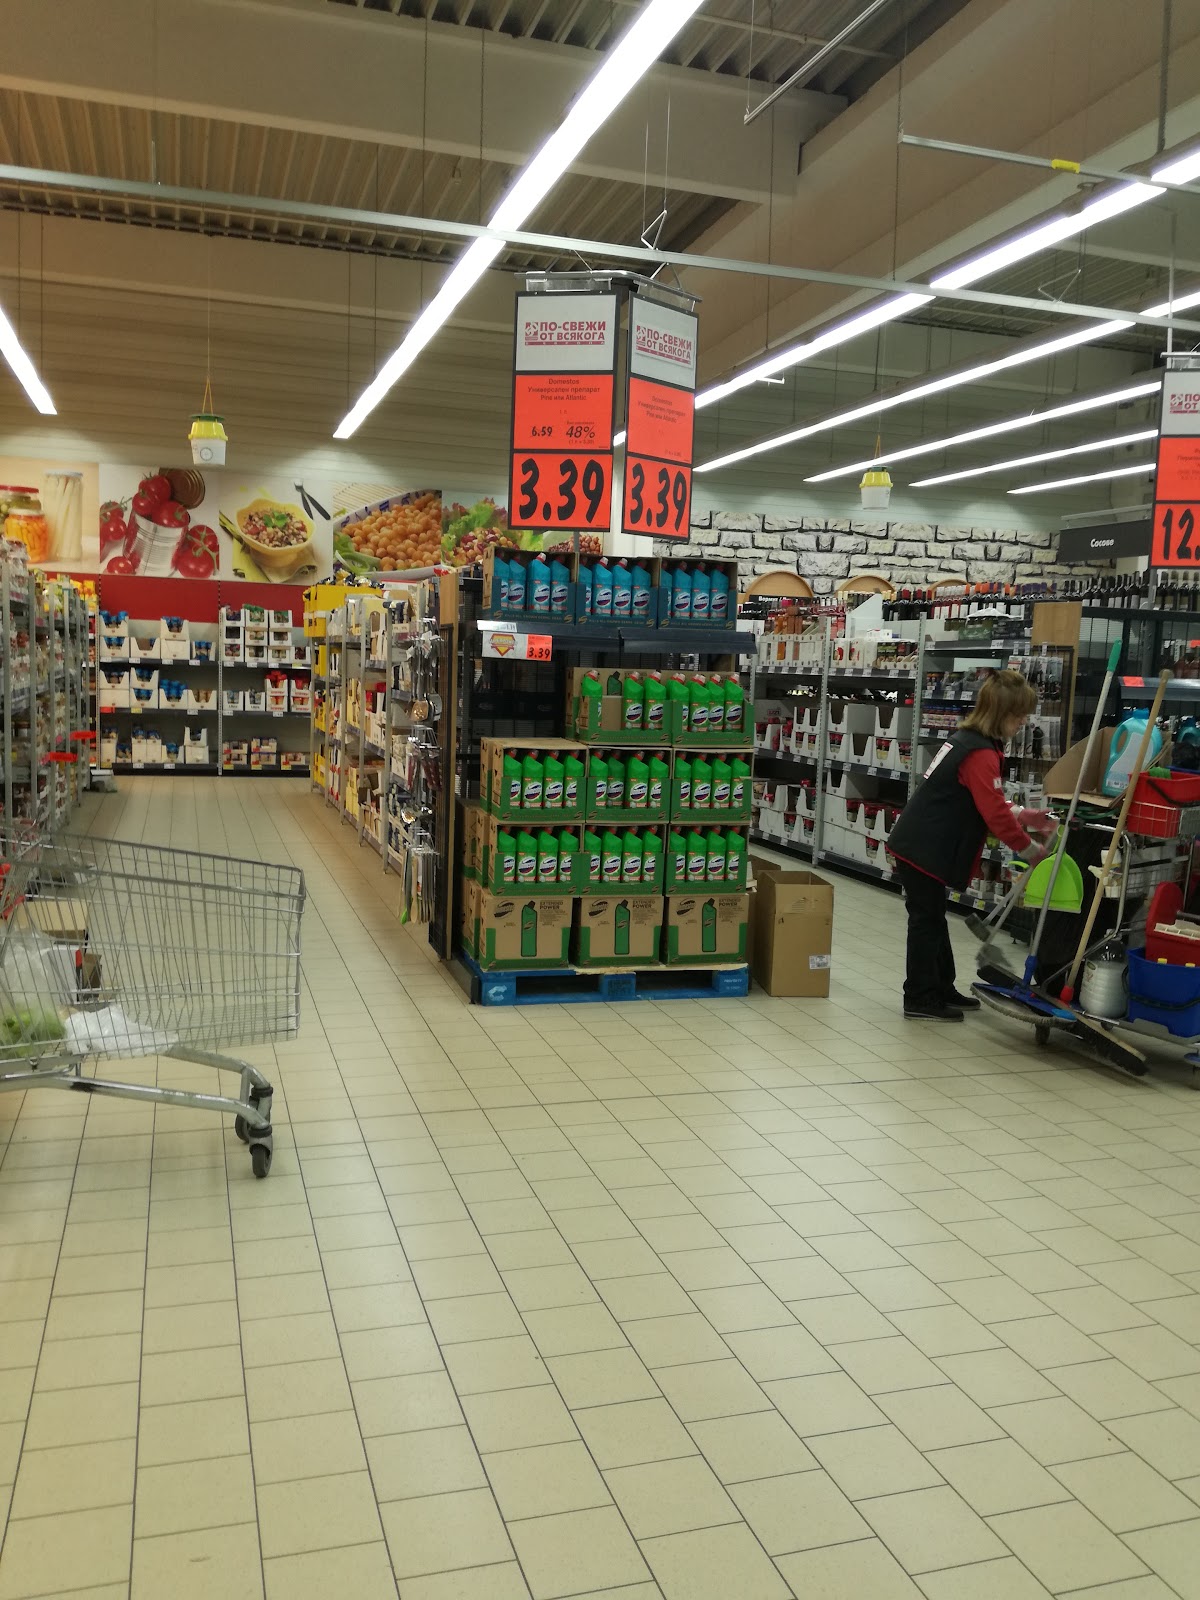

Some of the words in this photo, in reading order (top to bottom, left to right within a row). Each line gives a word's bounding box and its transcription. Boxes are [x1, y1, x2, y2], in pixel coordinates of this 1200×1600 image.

[540, 321, 606, 332] ПО-СВЕЖИ
[540, 332, 554, 341] ОТ
[556, 331, 605, 341] ВСЯКОГА
[646, 328, 692, 351] ПО-СВЕЖИ
[646, 339, 657, 350] ОТ
[658, 342, 691, 360] ВСЯКОГА
[531, 425, 553, 437] 6.59
[565, 425, 596, 439] 48%
[519, 457, 605, 524] 3.39
[629, 462, 687, 533] 3.39
[528, 646, 551, 660] 3.39
